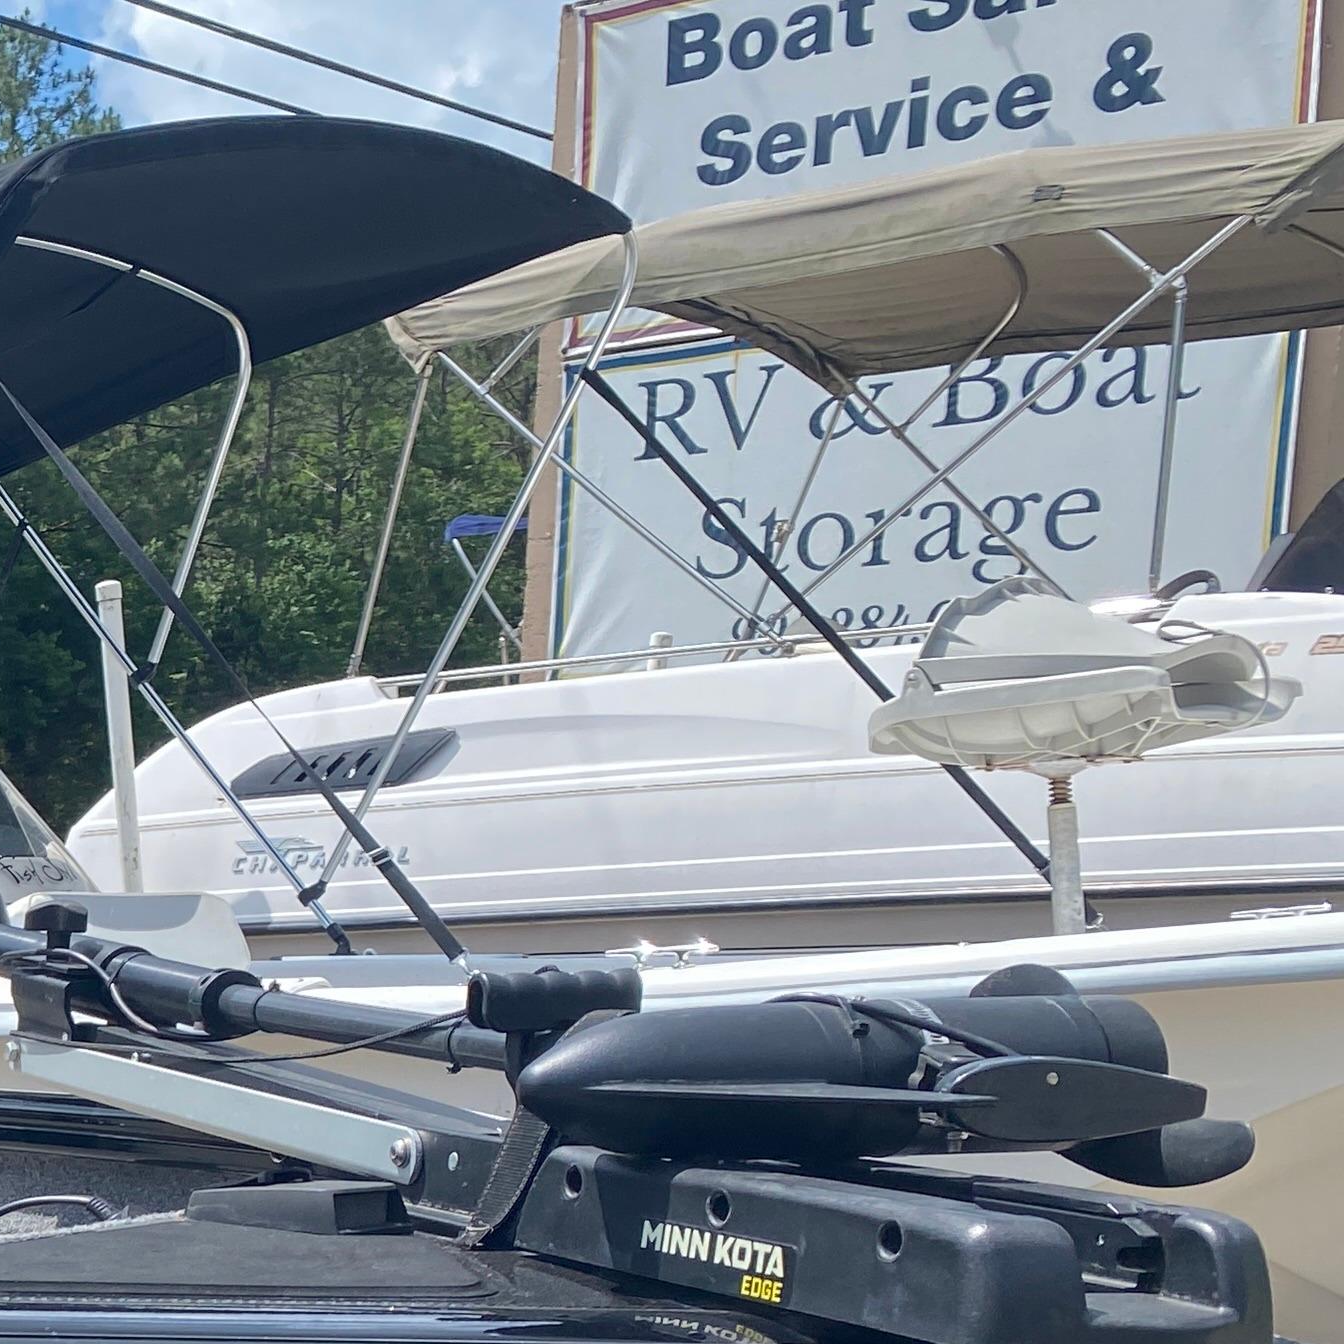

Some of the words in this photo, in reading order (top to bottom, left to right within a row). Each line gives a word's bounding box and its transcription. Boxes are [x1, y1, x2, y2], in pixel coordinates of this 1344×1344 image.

[666, 0, 874, 87] Boat
[696, 72, 1053, 187] Service
[1092, 31, 1166, 114] &
[634, 363, 785, 462] RV
[808, 380, 895, 440] &
[696, 485, 1101, 585] Storage
[640, 1219, 712, 1262] MINN
[713, 1233, 785, 1279] KOTA
[740, 1273, 784, 1304] EDGE
